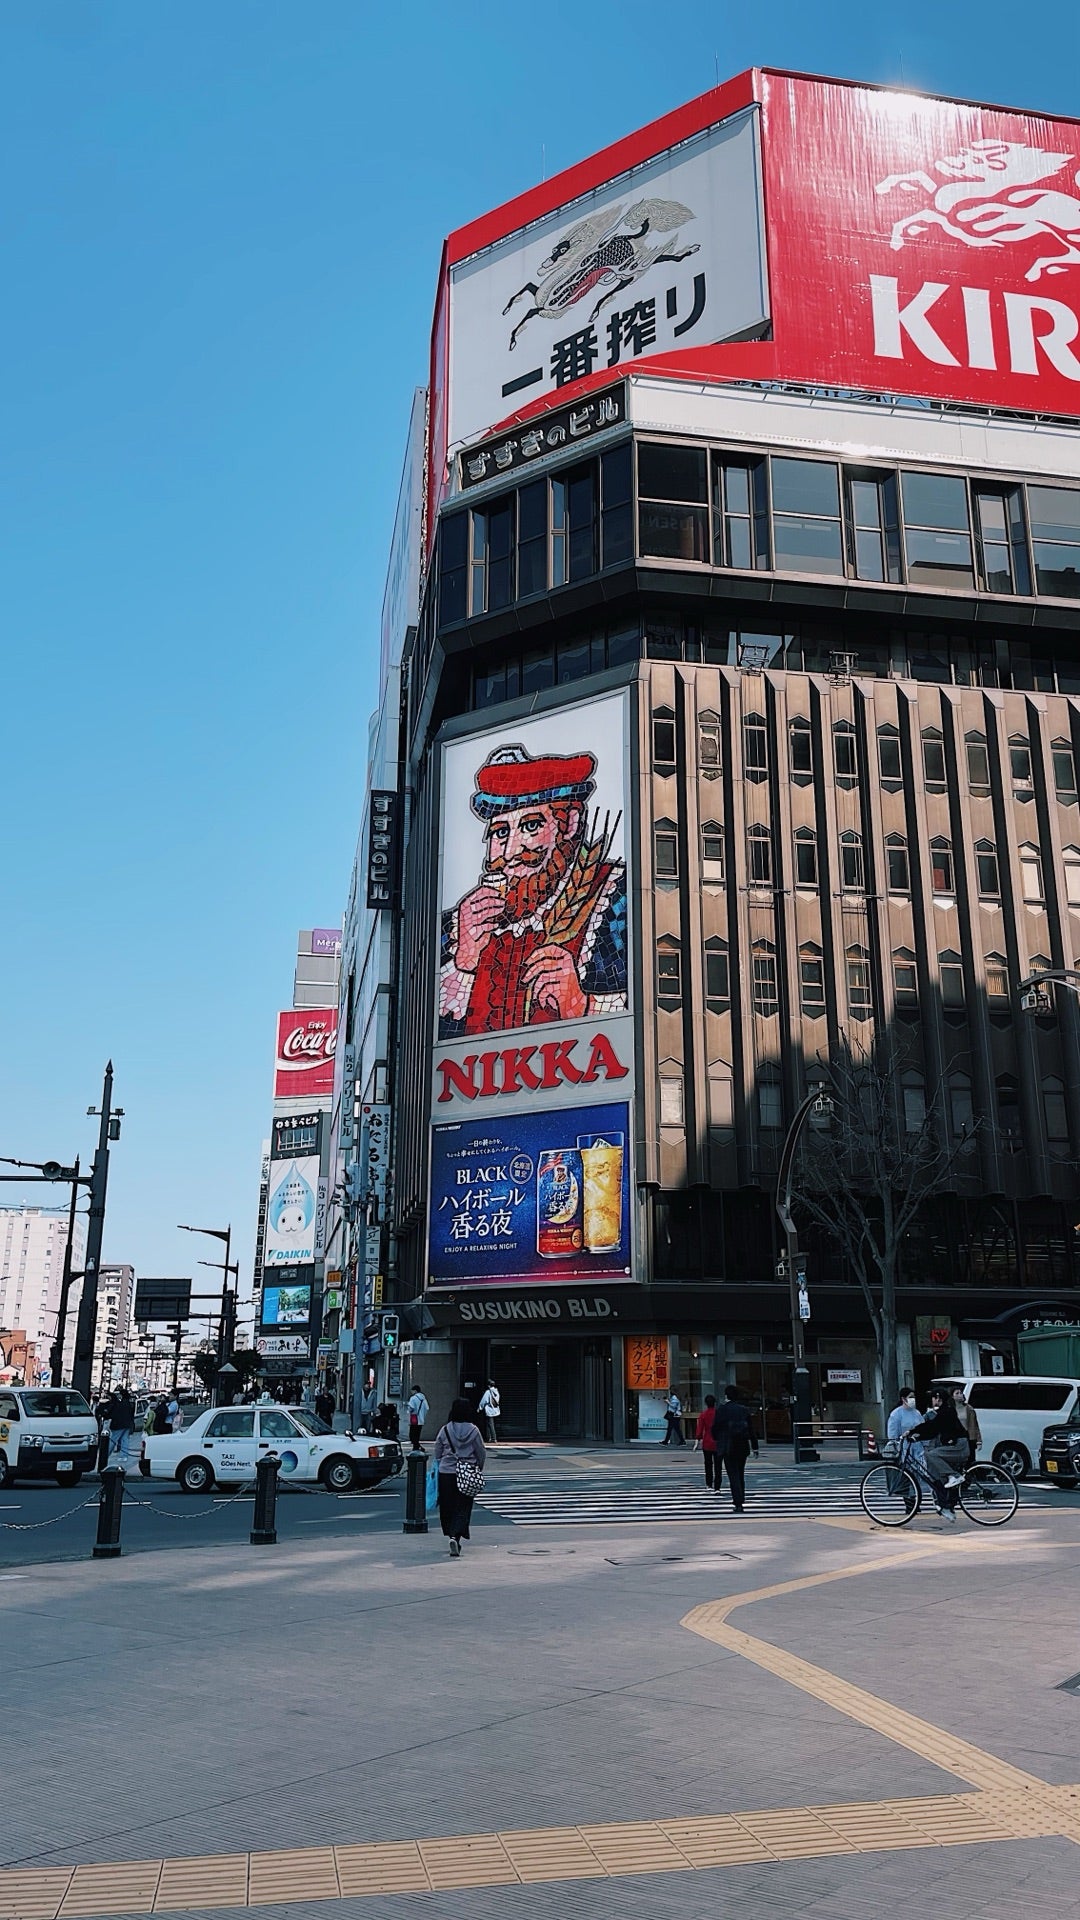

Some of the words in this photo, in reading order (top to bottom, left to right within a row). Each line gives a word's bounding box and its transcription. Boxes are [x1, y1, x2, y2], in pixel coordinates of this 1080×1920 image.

[501, 272, 706, 398] 一番搾り
[869, 274, 1080, 382] KIR
[467, 397, 619, 481] すすきのビル
[370, 796, 392, 900] すすきのビル
[308, 1021, 328, 1030] Enjoy
[284, 1027, 337, 1057] Coca-C
[436, 1033, 630, 1103] NIKKA
[456, 1165, 508, 1185] BLACK
[438, 1187, 526, 1211] ハイボール
[449, 1208, 514, 1240] 香る夜
[276, 1249, 312, 1260] DAIKIN
[444, 1246, 463, 1254] ENJOY
[469, 1243, 498, 1251] RELAXING
[499, 1242, 518, 1250] NIGHT
[459, 1300, 561, 1321] SUSUKINO
[567, 1298, 619, 1317] BLD.
[643, 1339, 656, 1384] タイムズ
[654, 1339, 667, 1367] 札幌
